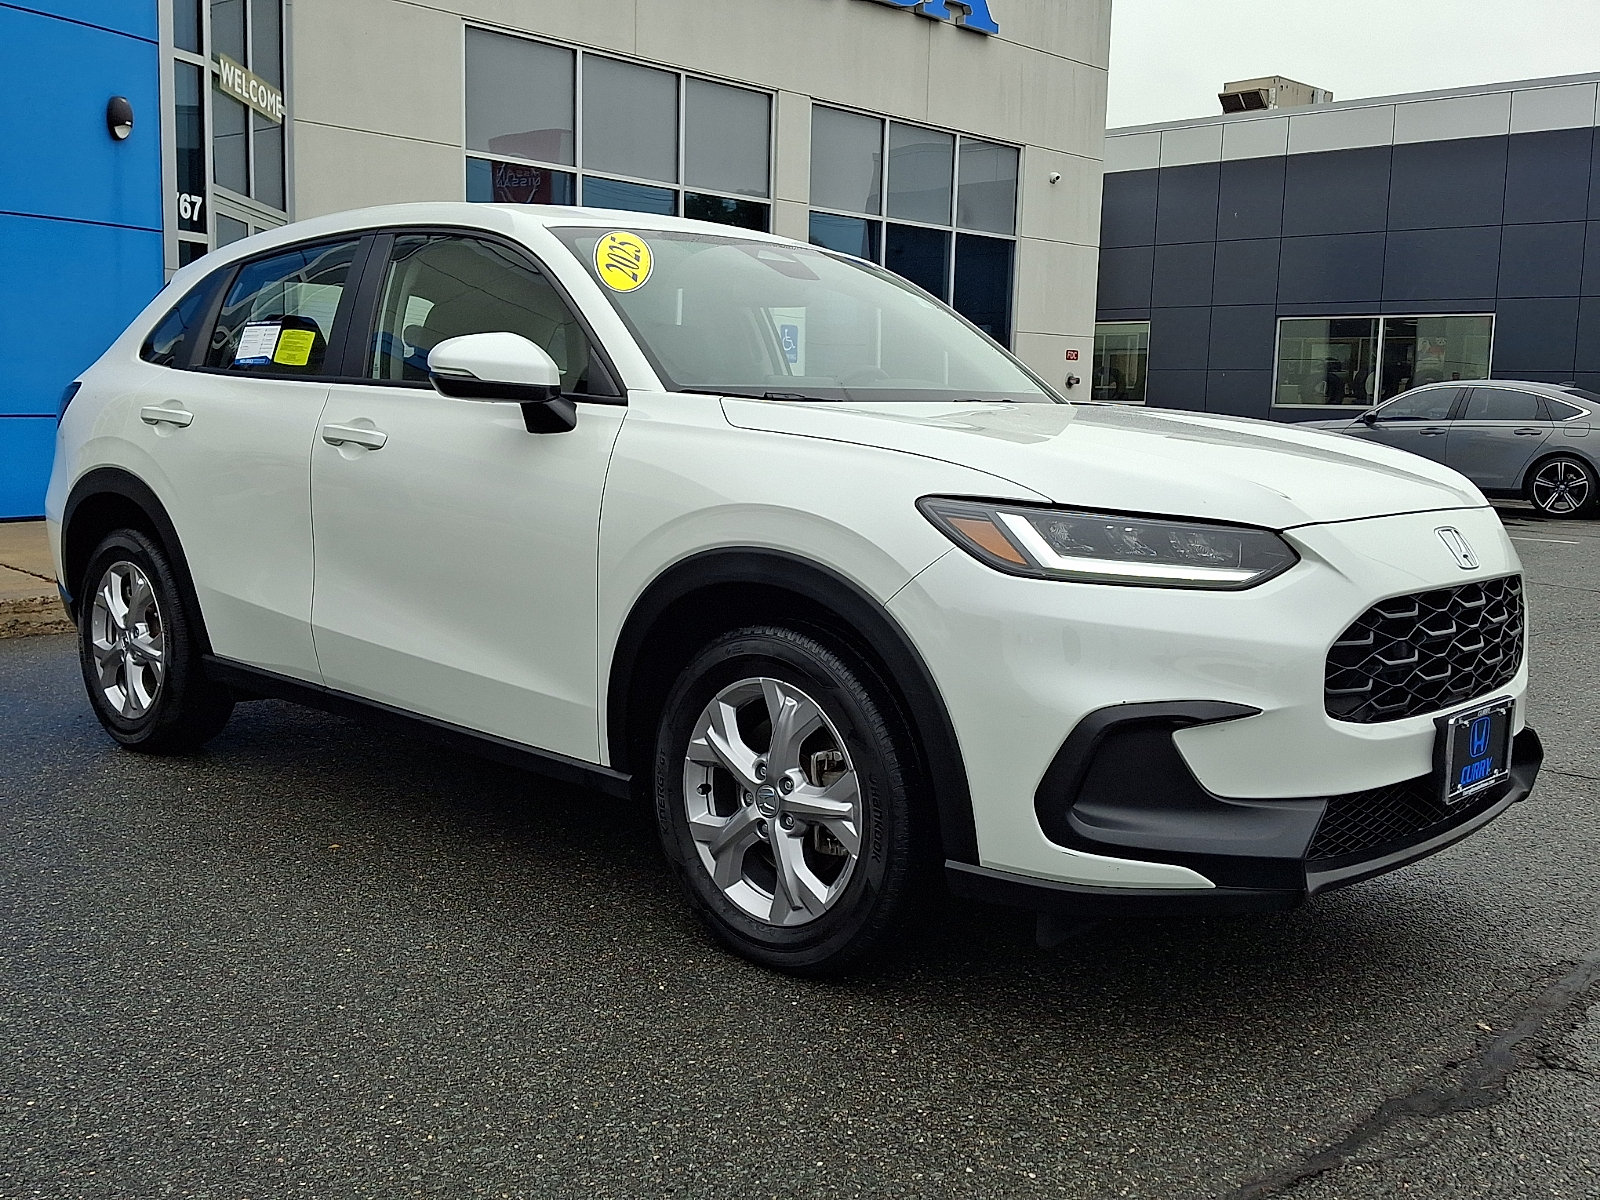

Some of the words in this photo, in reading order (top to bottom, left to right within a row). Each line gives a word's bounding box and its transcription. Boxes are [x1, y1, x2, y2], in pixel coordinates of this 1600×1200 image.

[220, 58, 282, 119] WELCOME
[605, 235, 641, 283] 2025
[1067, 351, 1077, 360] FDC
[1460, 756, 1493, 785] CURRY
